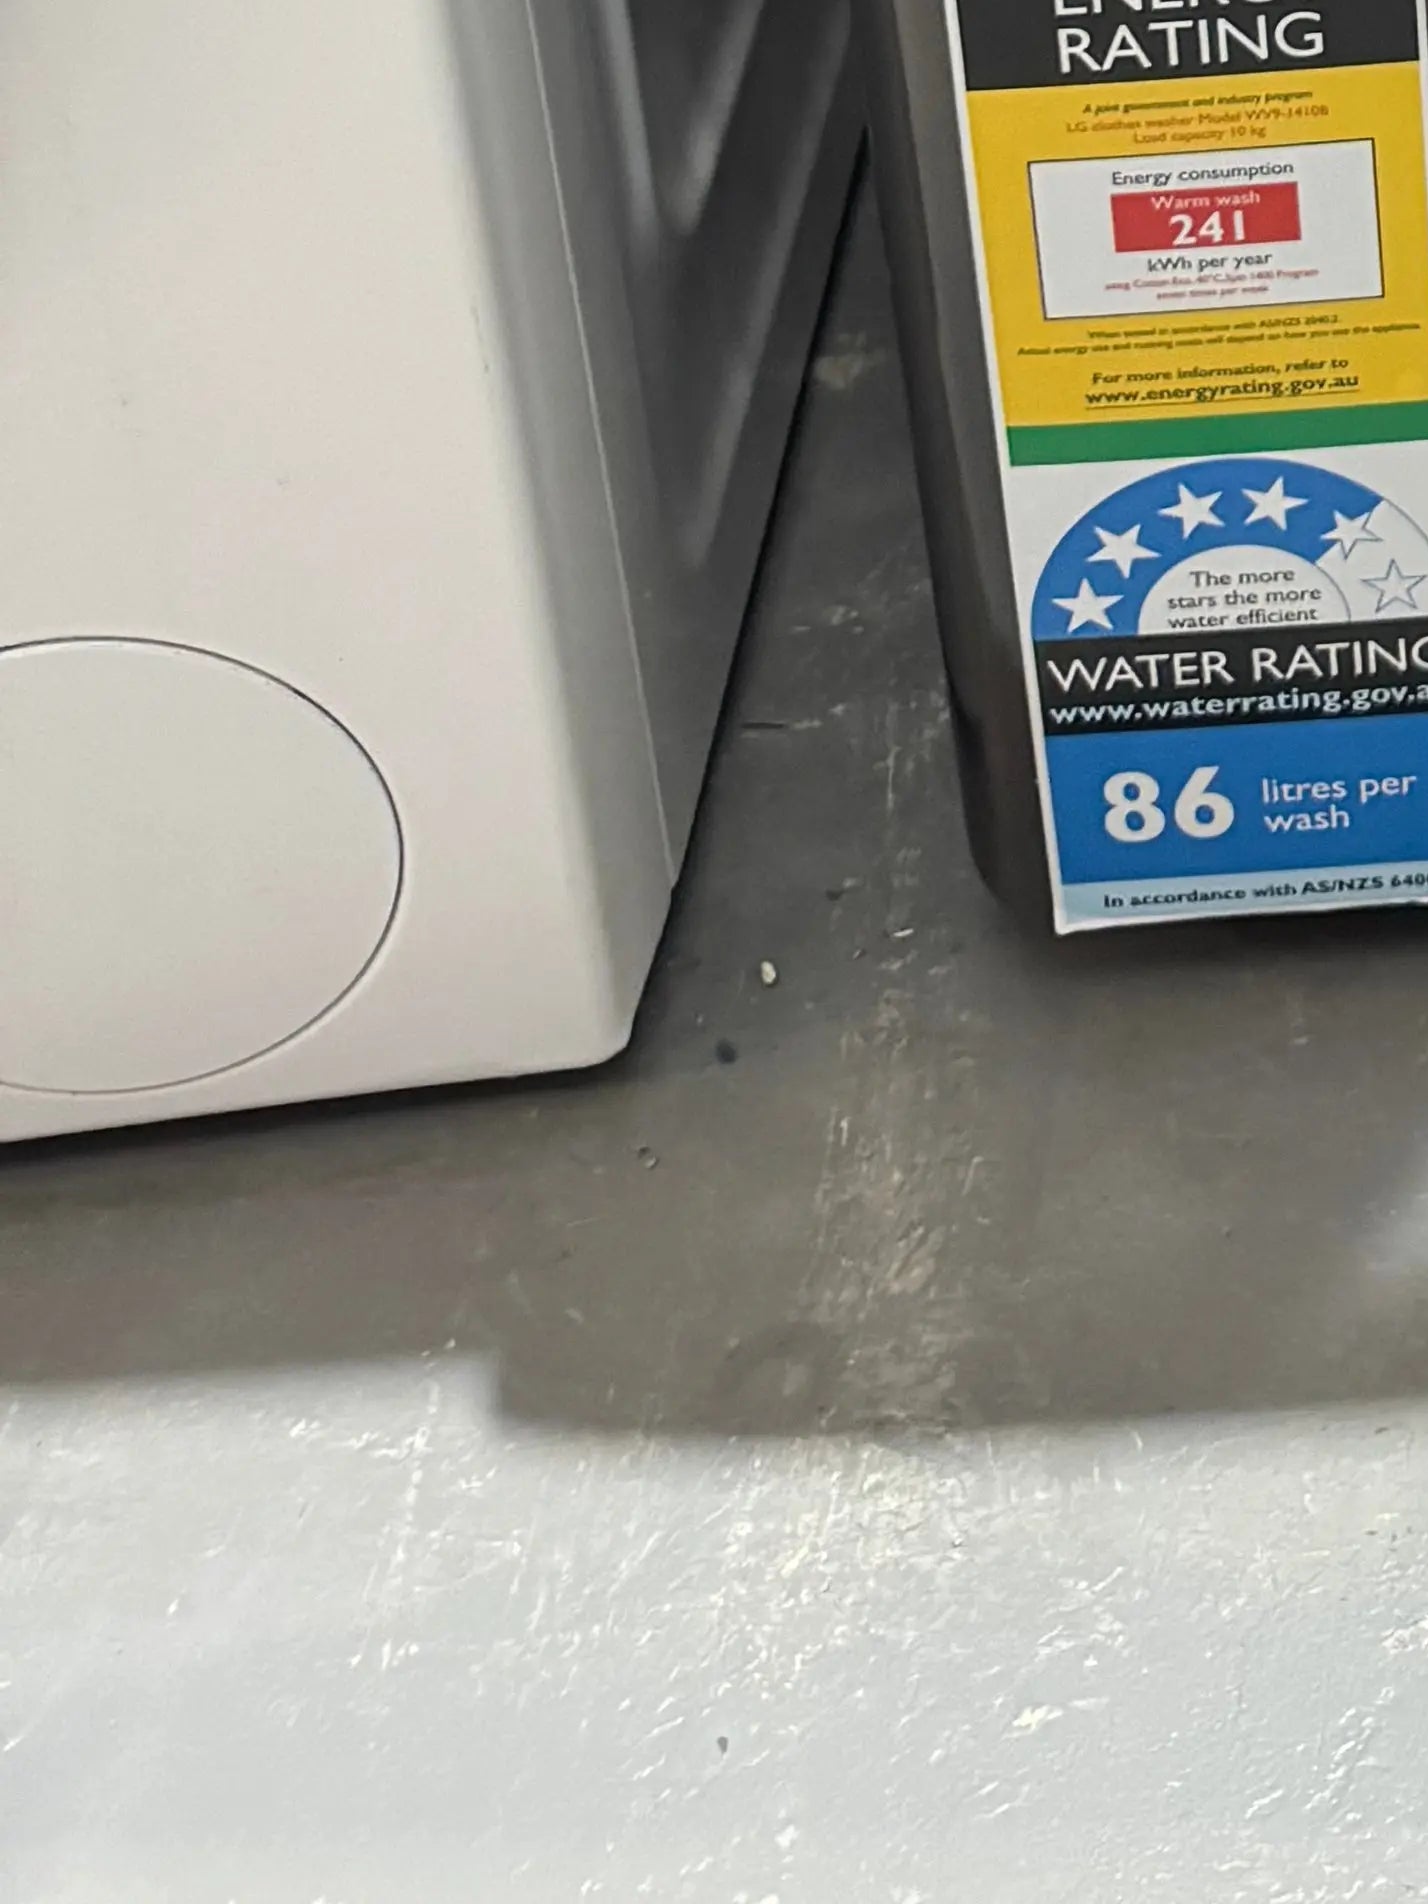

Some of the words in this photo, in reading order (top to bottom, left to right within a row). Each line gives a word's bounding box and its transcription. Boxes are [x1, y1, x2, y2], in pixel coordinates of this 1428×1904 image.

[1057, 11, 1325, 74] RATING
[1111, 170, 1172, 188] Energy
[1178, 161, 1294, 181] consumption
[1152, 195, 1211, 210] Warm
[1216, 191, 1260, 206] wash
[1169, 210, 1246, 246] 241
[1147, 256, 1193, 273] kWh
[1199, 255, 1227, 272] per
[1233, 252, 1273, 270] year
[1092, 371, 1121, 385] For
[1125, 369, 1173, 383] more
[1177, 361, 1280, 380] information,
[1285, 359, 1326, 374] refer
[1330, 358, 1348, 369] to
[1085, 374, 1360, 402] www.energyrating.gov.au
[1189, 570, 1230, 587] The
[1239, 568, 1294, 584] more
[1167, 594, 1217, 609] stars
[1224, 590, 1259, 606] the
[1265, 587, 1321, 603] more
[1167, 615, 1229, 629] water
[1236, 607, 1318, 624] efficient
[1048, 649, 1235, 692] WATER
[1103, 765, 1235, 843] 86
[1262, 777, 1347, 805] litres
[1360, 775, 1417, 804] per
[1264, 804, 1349, 833] wash
[1103, 894, 1122, 908] In
[1130, 888, 1246, 907] accordance
[1252, 882, 1297, 898] with
[1302, 874, 1385, 895] AS/NZS
